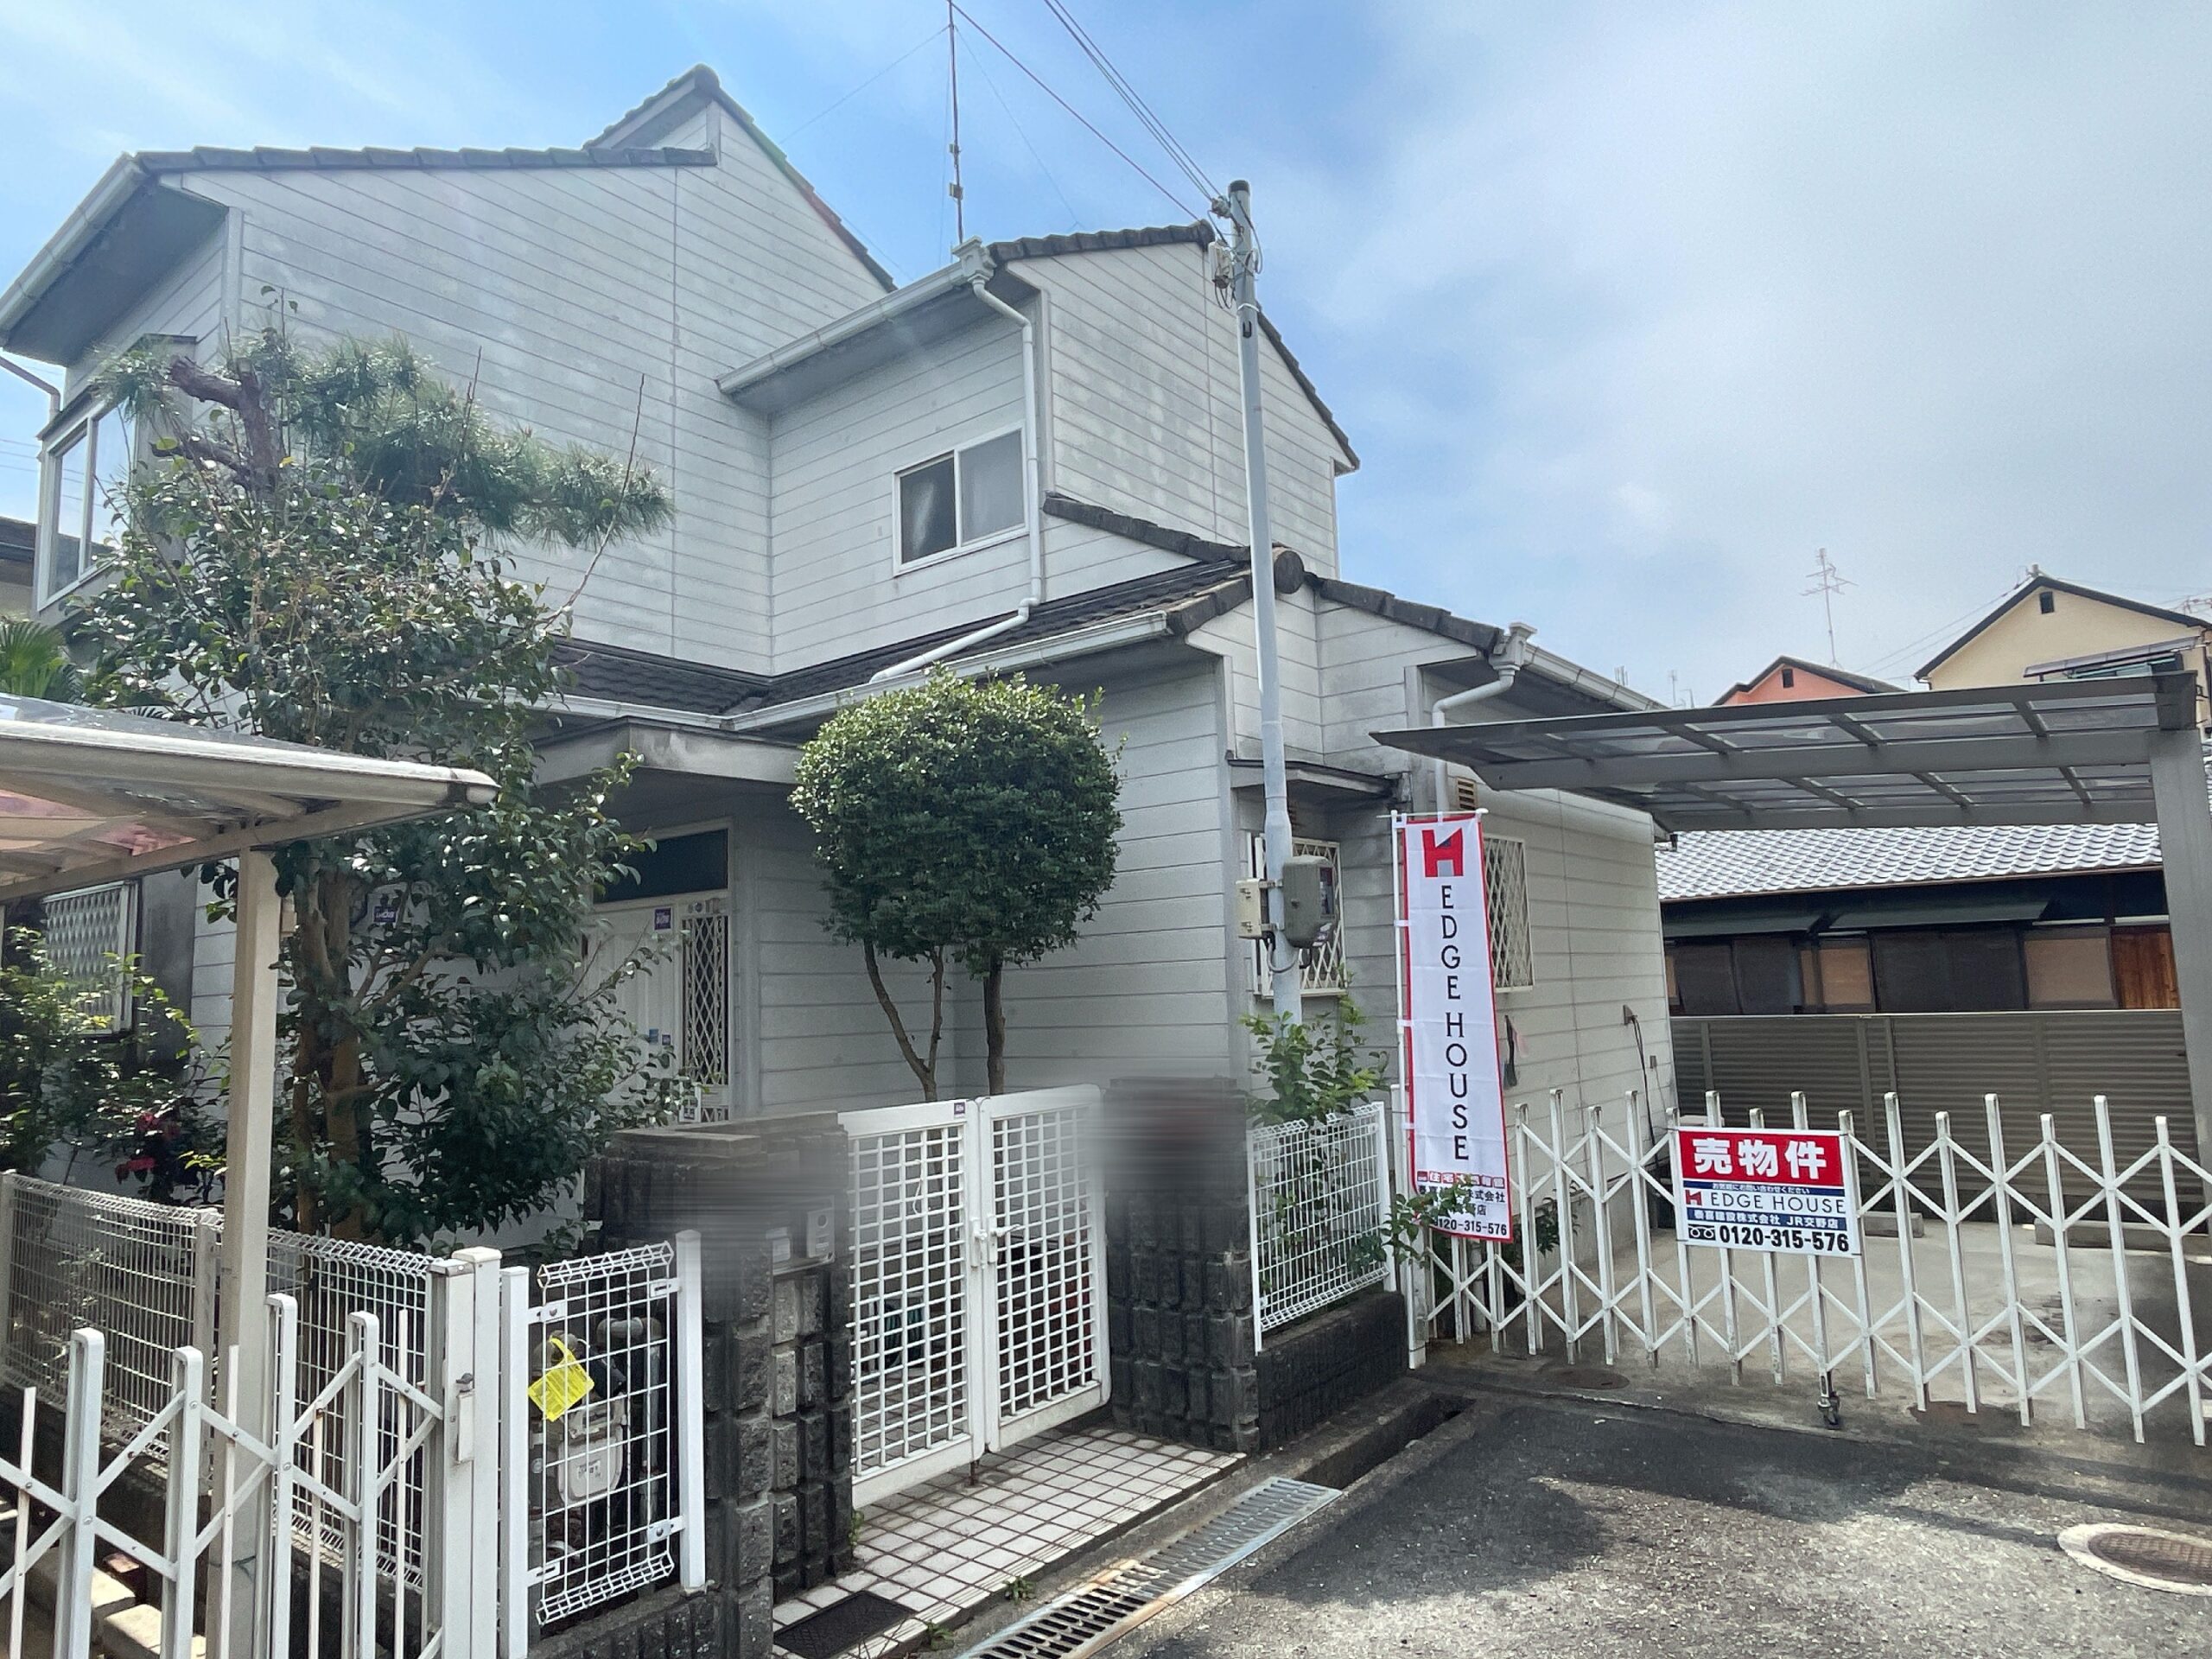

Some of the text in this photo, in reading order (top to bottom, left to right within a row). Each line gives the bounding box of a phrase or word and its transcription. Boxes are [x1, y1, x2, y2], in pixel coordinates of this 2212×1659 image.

[1446, 1012, 1469, 1160] HOUSE
[1692, 1137, 1827, 1179] 売物件
[1773, 1196, 1847, 1214] HOUSE
[1719, 1224, 1849, 1252] 0120-315-576
